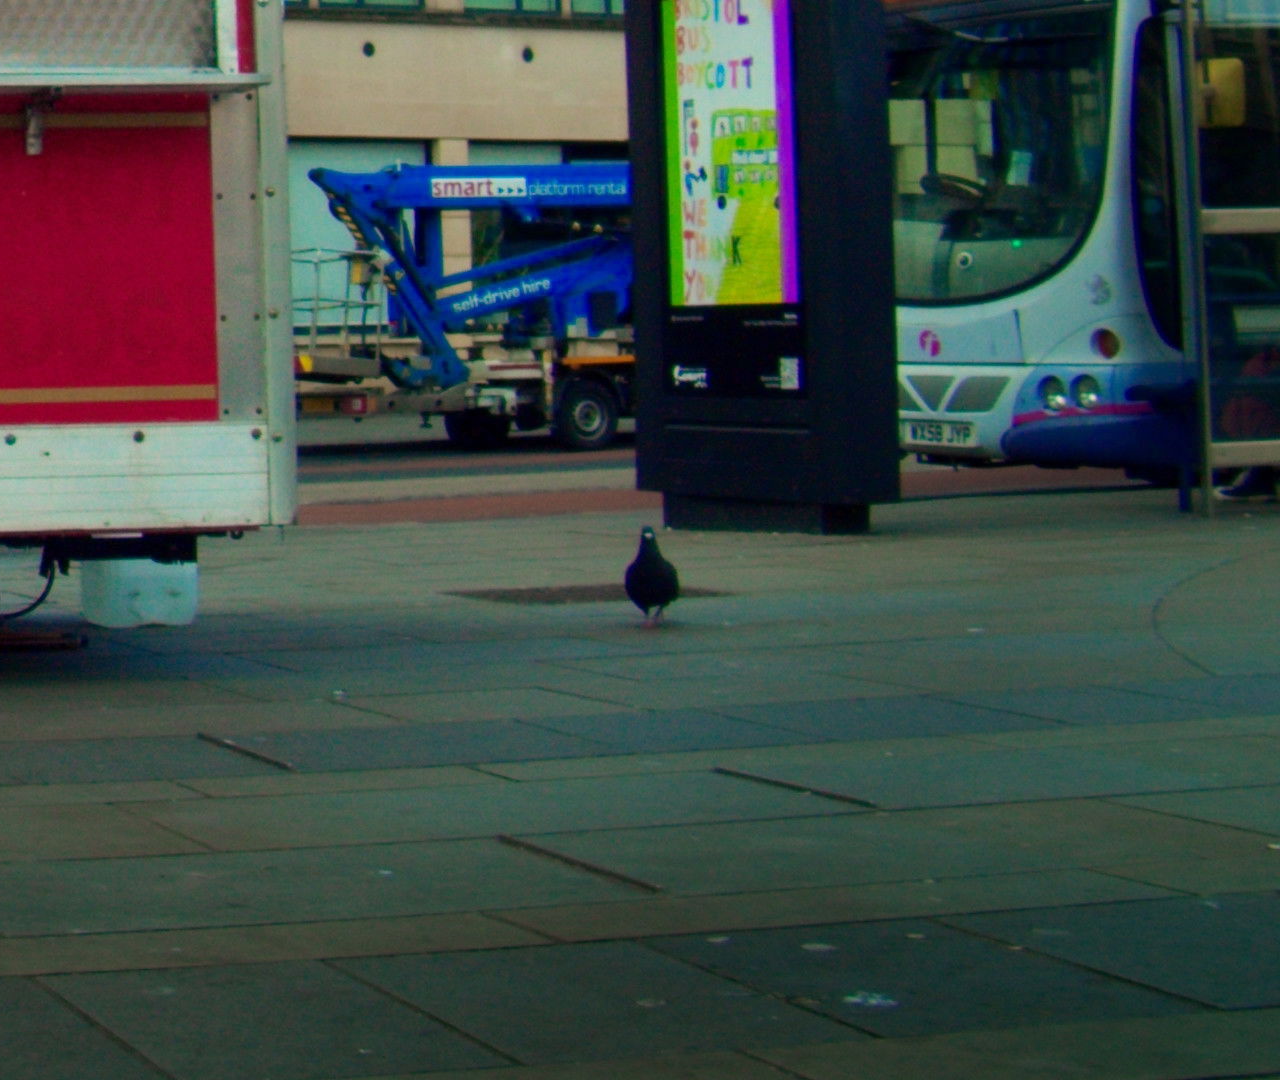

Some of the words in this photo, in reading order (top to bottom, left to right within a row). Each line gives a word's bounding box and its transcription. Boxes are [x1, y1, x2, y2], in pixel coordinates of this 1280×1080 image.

[676, 25, 712, 56] BUS
[676, 56, 754, 90] BOYCOTT
[431, 178, 493, 197] smart
[528, 180, 585, 200] platform
[588, 181, 627, 195] rental
[453, 286, 520, 314] self-drive
[522, 277, 551, 296] hire
